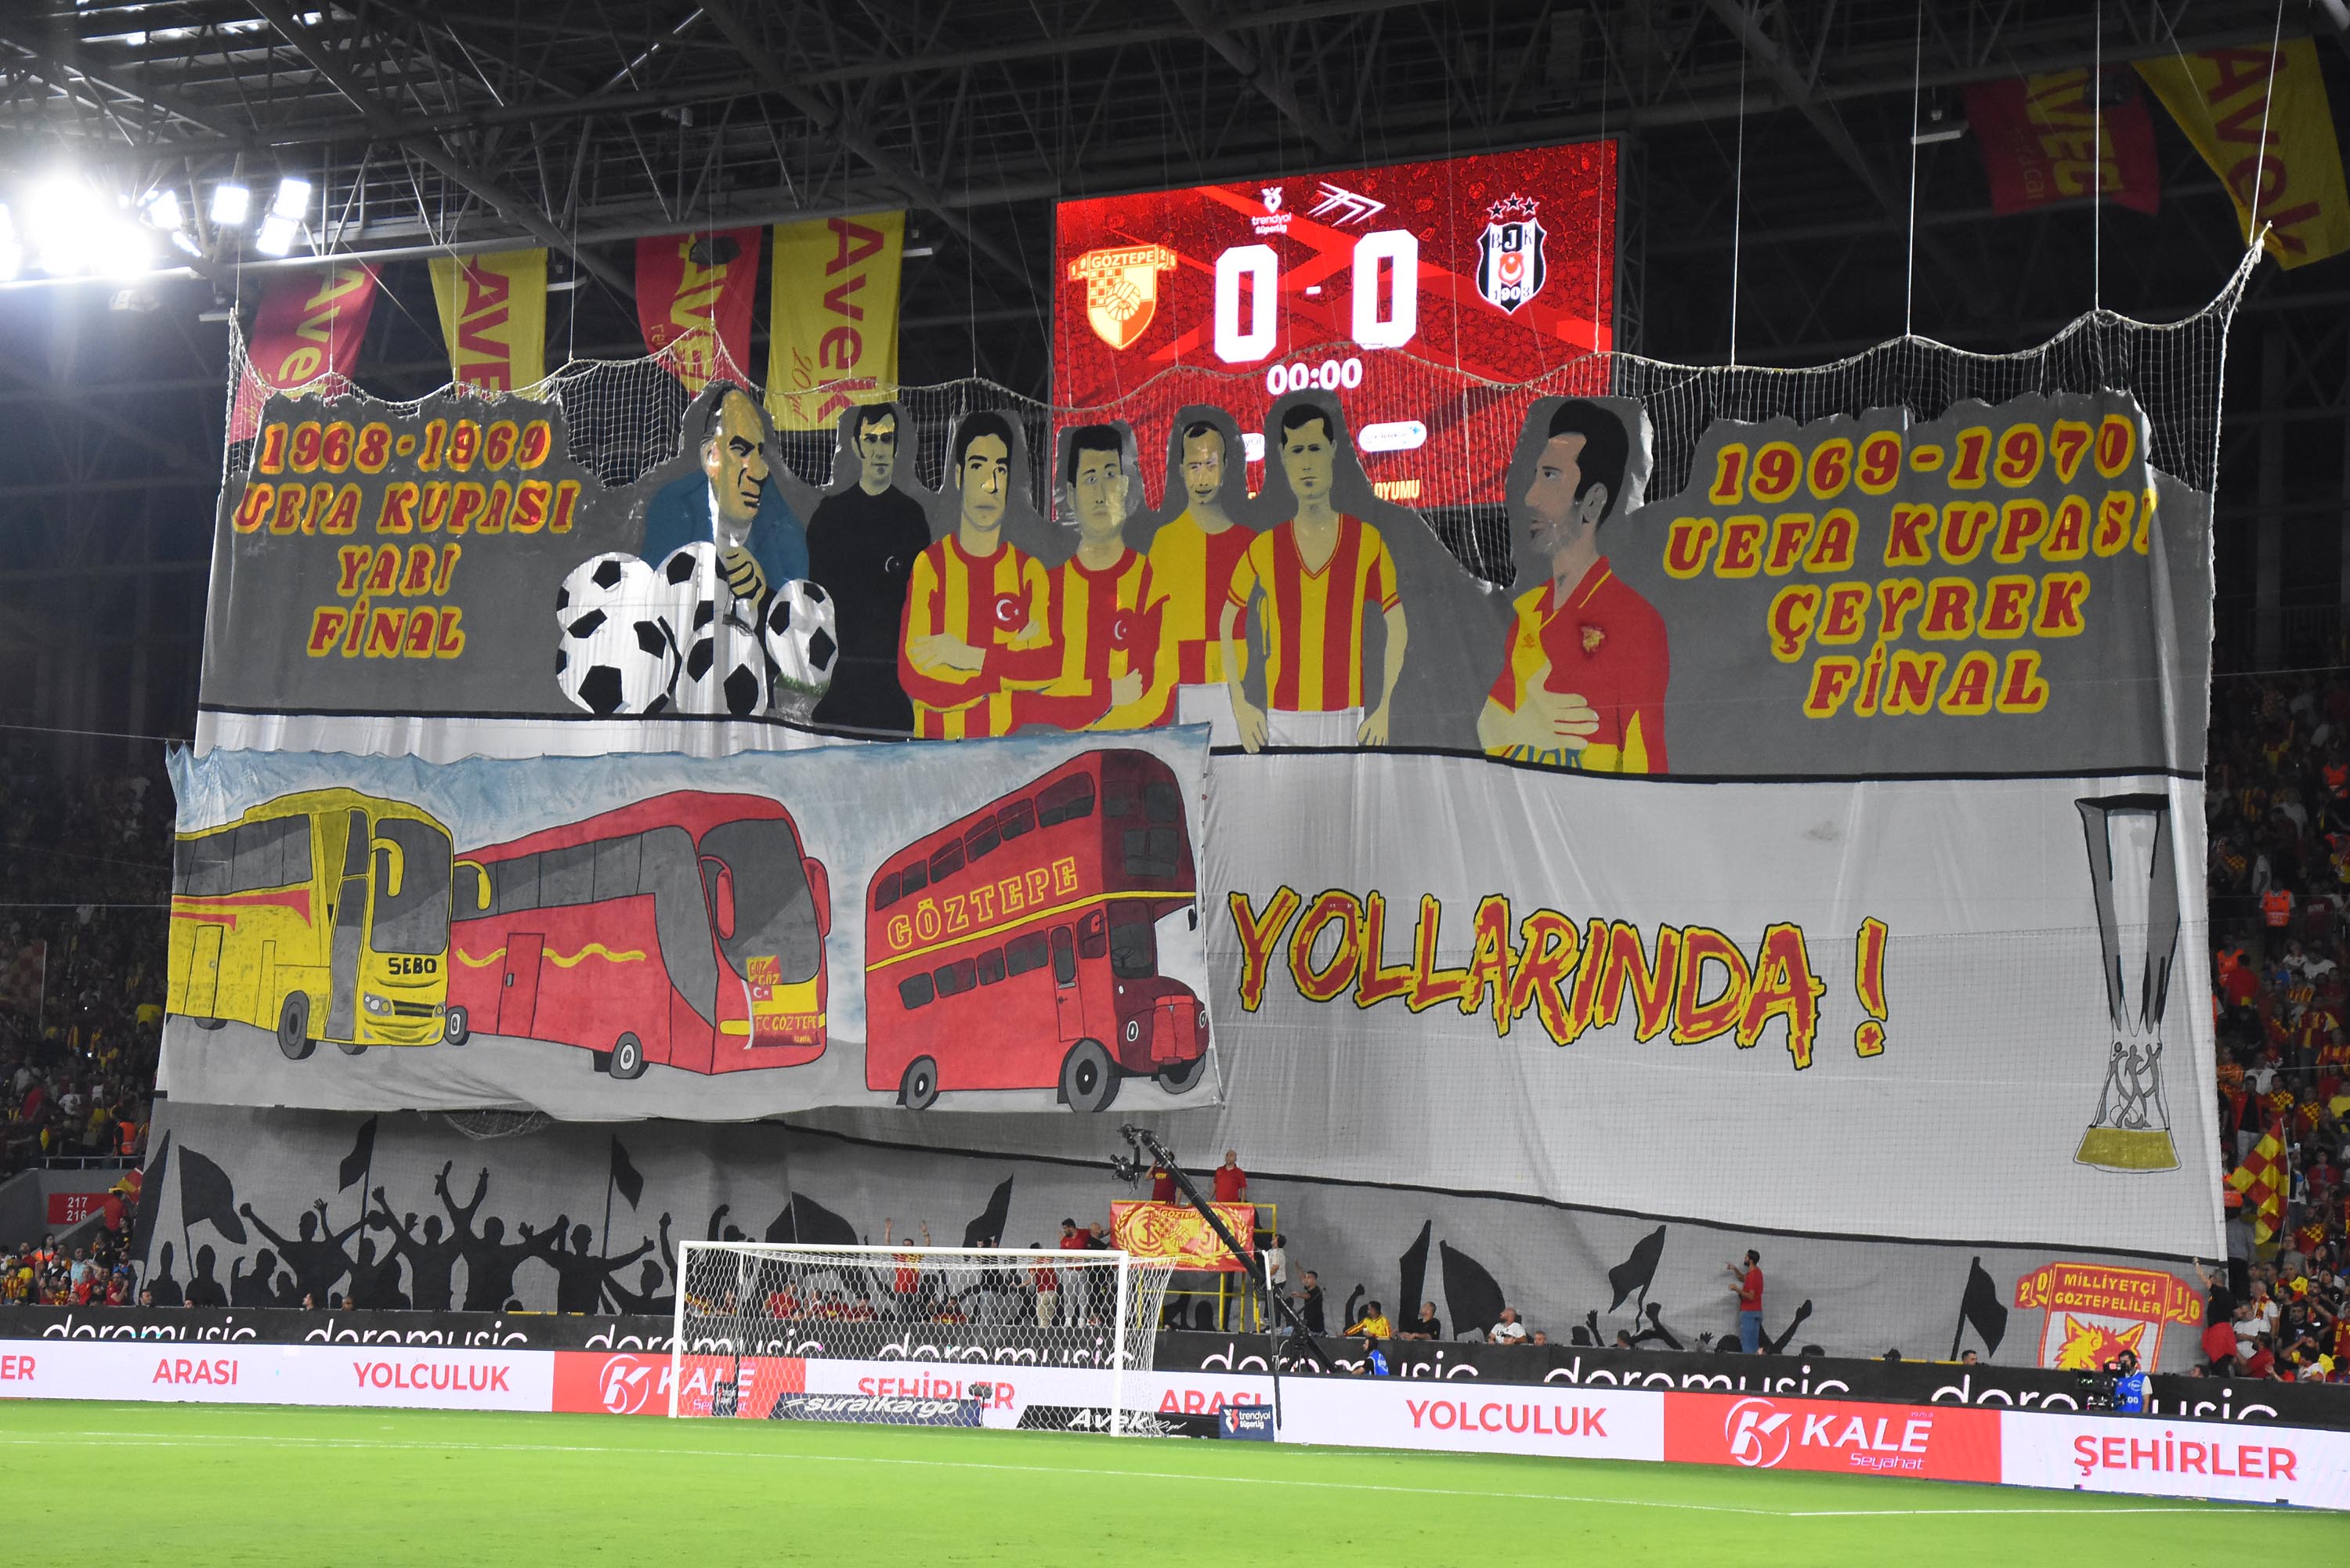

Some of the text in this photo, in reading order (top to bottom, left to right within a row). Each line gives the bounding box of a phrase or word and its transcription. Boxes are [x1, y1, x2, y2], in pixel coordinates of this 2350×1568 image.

[1252, 211, 1292, 225] trendyol
[1090, 251, 1155, 269] GÖZTEPE
[817, 218, 884, 423] Avek
[1214, 244, 1278, 363] 0
[1352, 229, 1419, 349] 0
[277, 262, 367, 401] Ave
[1267, 358, 1363, 395] 00:00
[258, 417, 552, 475] 1968-1969
[1708, 414, 2135, 506] 1969-1970
[377, 479, 581, 535] KUPASI
[336, 541, 463, 598] YARI
[1662, 508, 1860, 580] UEFA
[306, 593, 466, 659] FİNAL
[1766, 570, 2091, 663] ÇEYREK
[1802, 638, 2049, 719] FİNAL
[887, 855, 1079, 952] GÖZTEPE
[387, 956, 439, 977] SEBO
[1227, 885, 1828, 1071] YOLLARINDA
[66, 1210, 88, 1222] 216
[67, 1197, 89, 1209] 217
[152, 1358, 239, 1386] ARASI
[353, 1362, 511, 1392] YOLCULUK
[1238, 1411, 1271, 1422] trendyol
[1405, 1399, 1608, 1438] YOLCULUK
[1800, 1413, 1933, 1453] KALE
[1849, 1452, 1925, 1471] Seyahat
[2073, 1429, 2298, 1481] ŞEHİRLER
